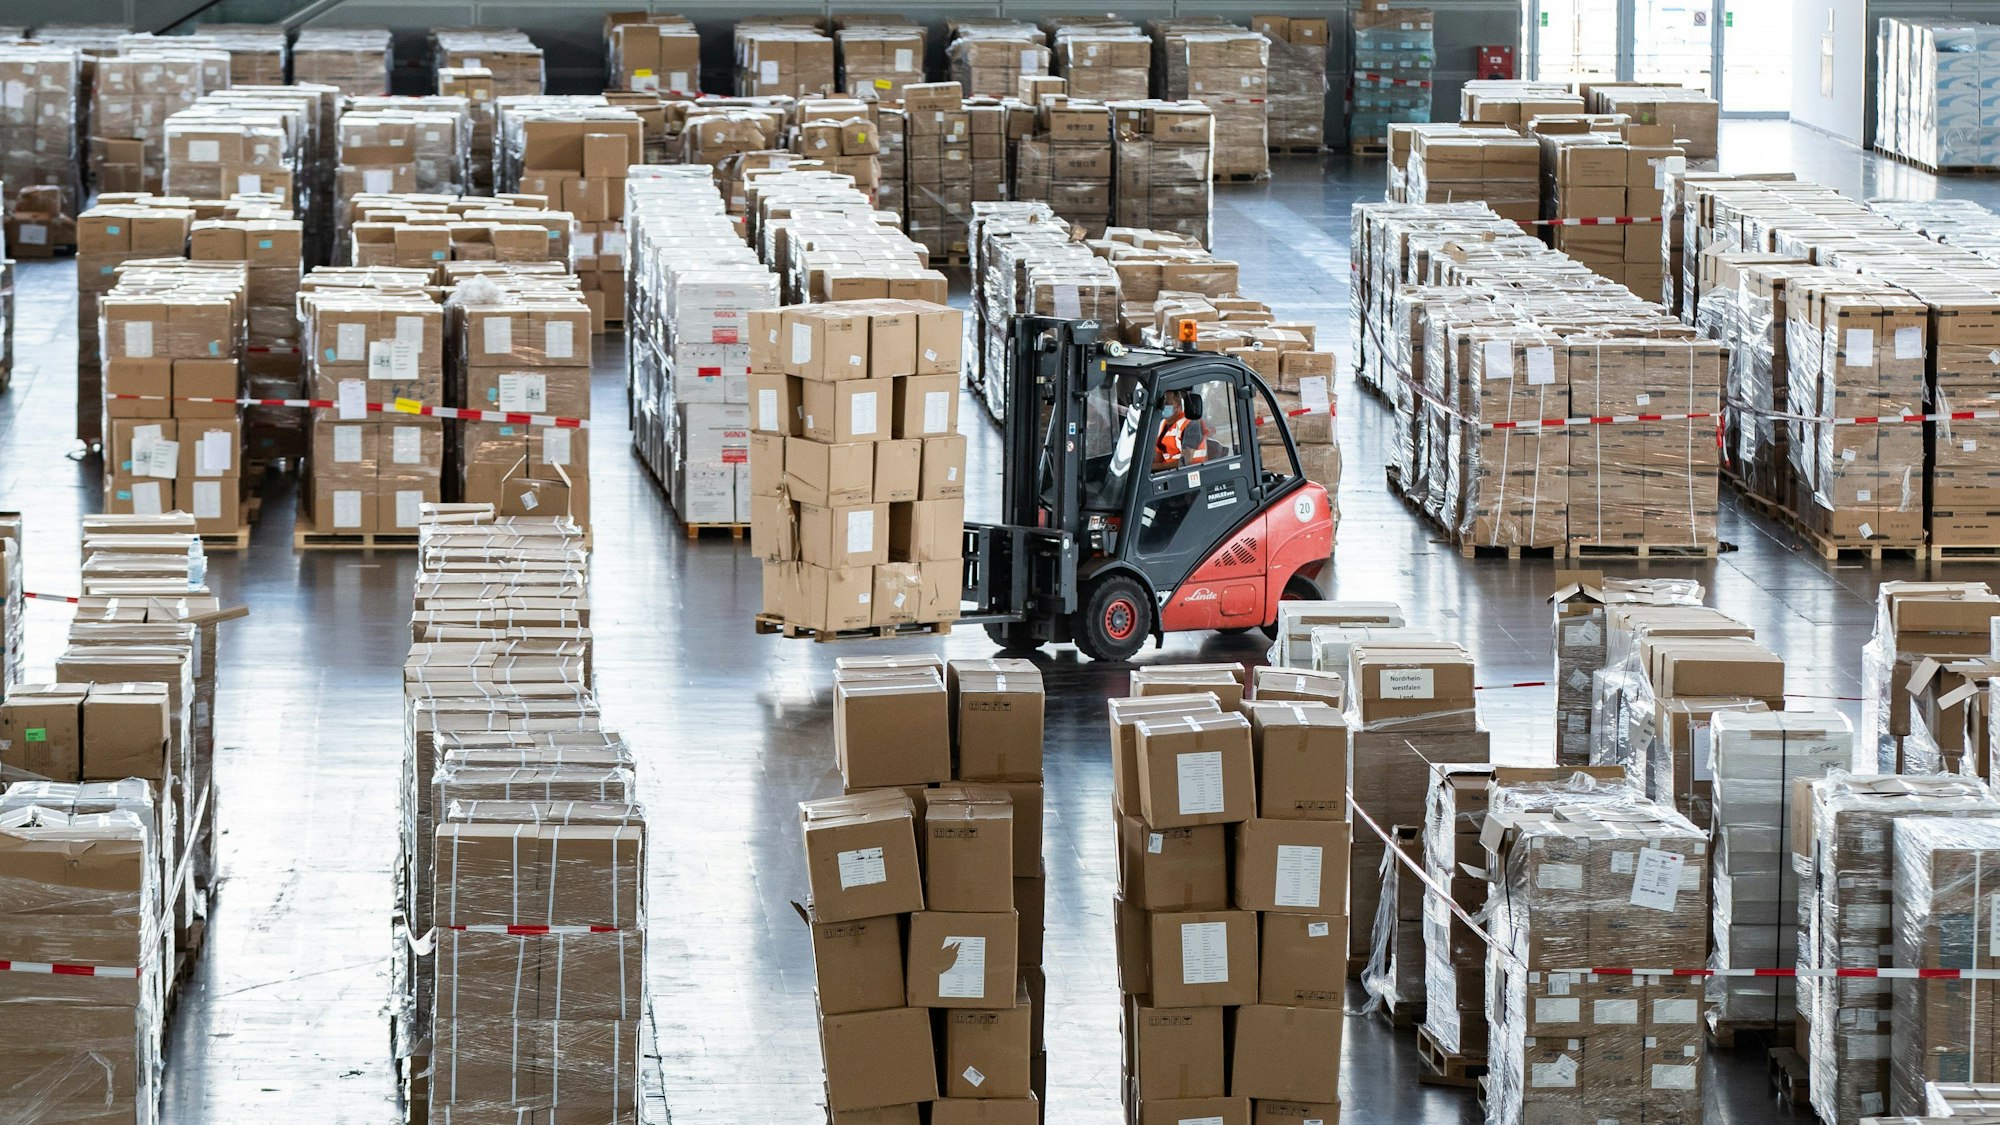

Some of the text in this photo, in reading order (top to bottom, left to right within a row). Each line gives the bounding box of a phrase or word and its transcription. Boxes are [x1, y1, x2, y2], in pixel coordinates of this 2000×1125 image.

[1077, 319, 1099, 329] Linde
[1300, 503, 1311, 514] 20
[1185, 588, 1217, 601] Linde
